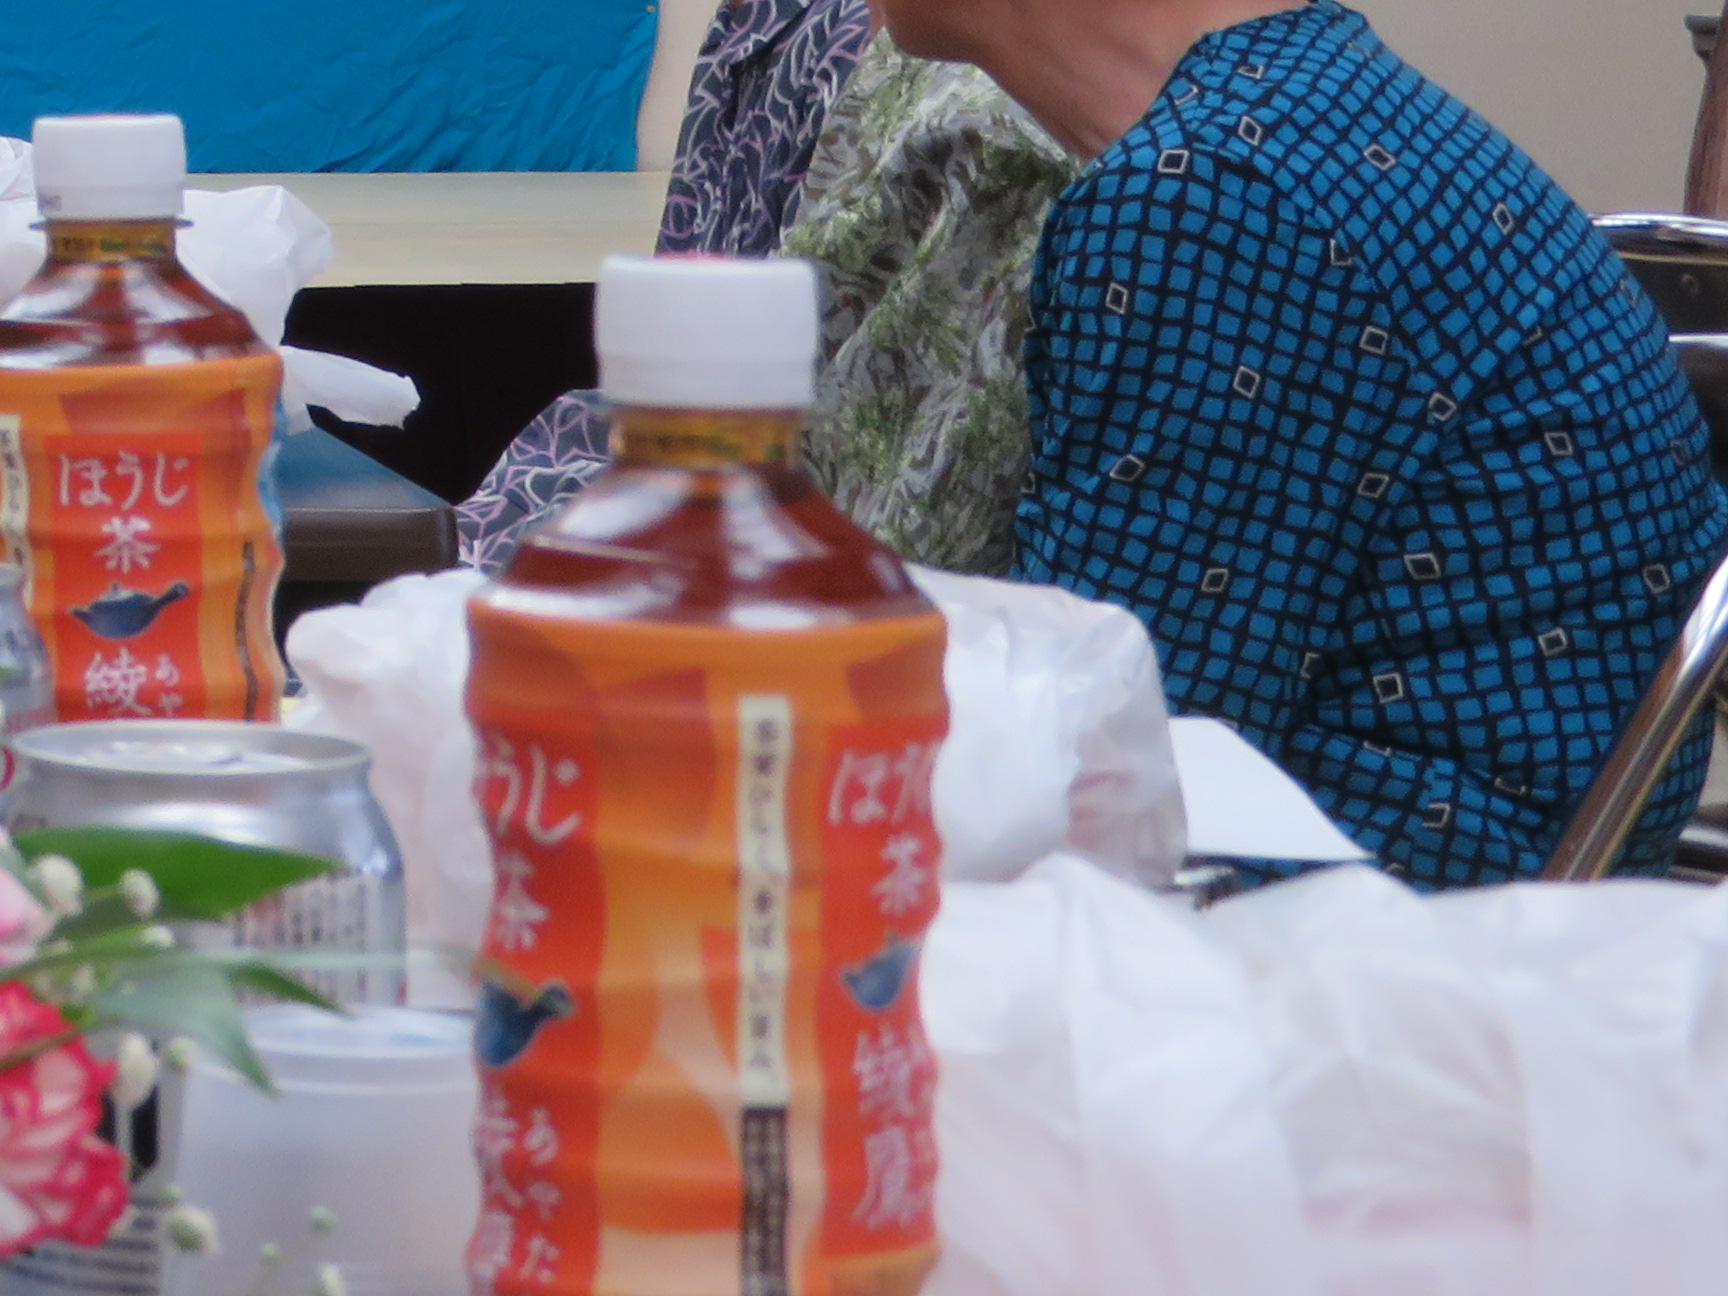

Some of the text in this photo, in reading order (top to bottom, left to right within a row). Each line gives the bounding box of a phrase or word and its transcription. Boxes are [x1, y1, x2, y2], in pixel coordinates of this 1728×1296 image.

[58, 450, 190, 511] ほうじ
[96, 515, 162, 575] 茶
[84, 645, 152, 716] 綾
[154, 652, 183, 716] あや
[522, 1109, 562, 1285] あやた
